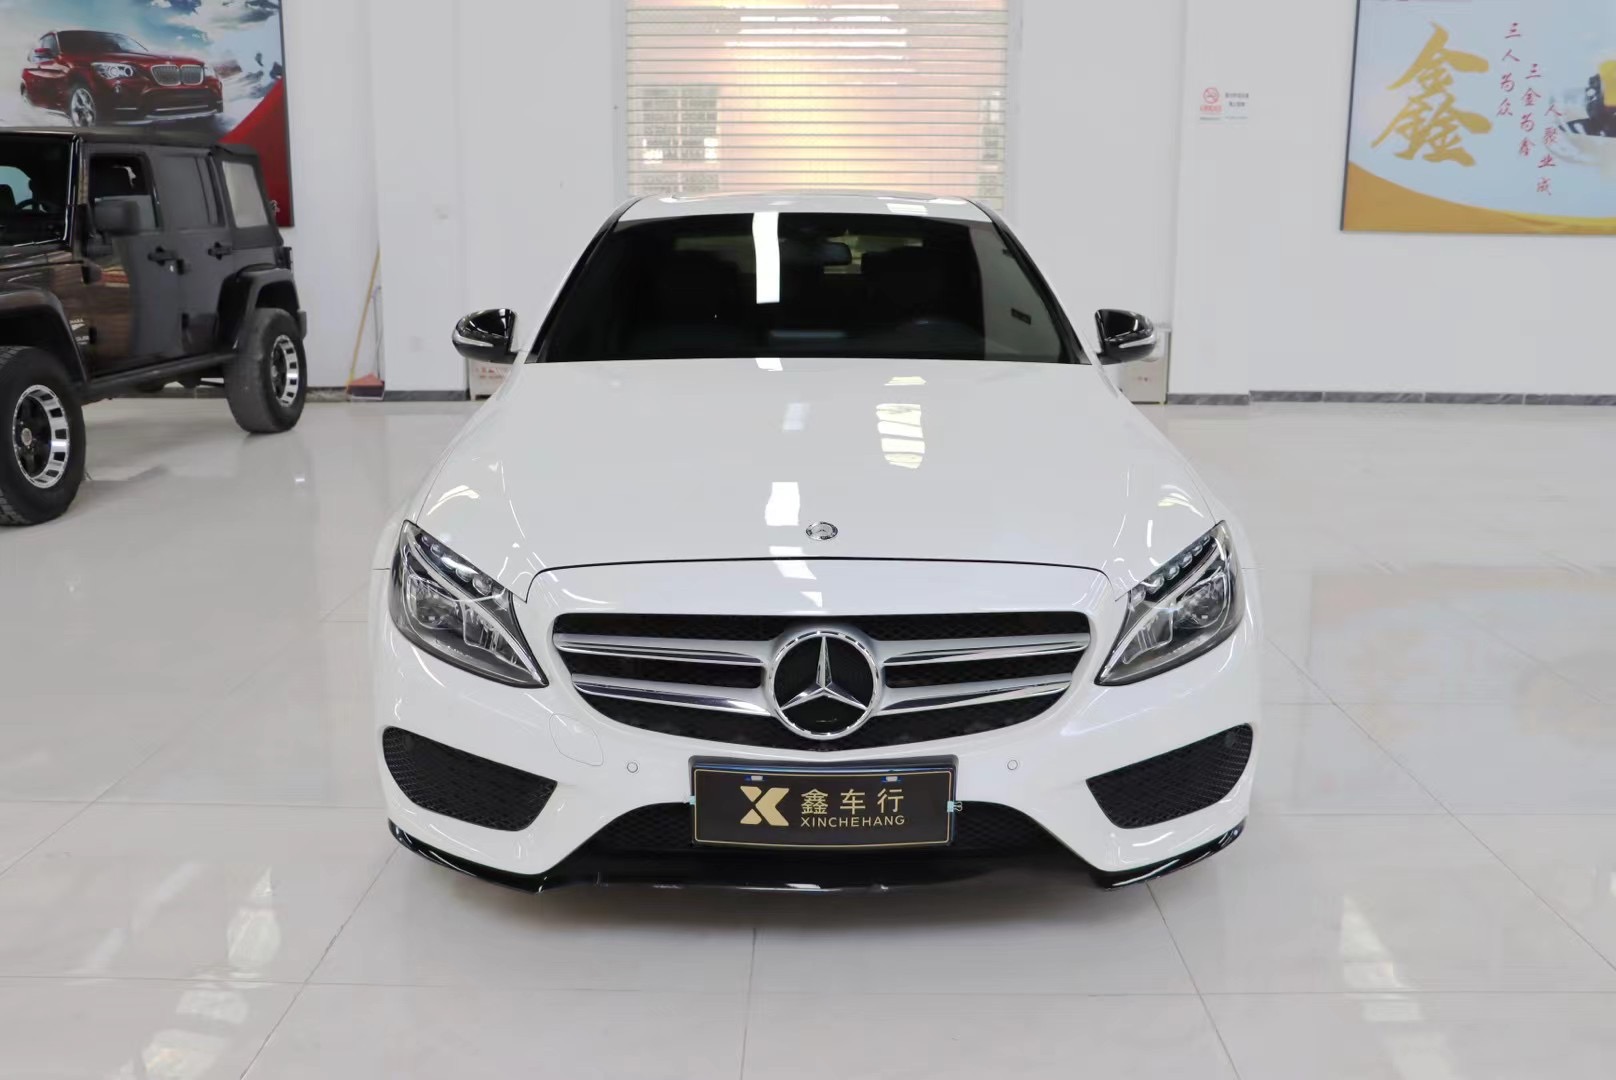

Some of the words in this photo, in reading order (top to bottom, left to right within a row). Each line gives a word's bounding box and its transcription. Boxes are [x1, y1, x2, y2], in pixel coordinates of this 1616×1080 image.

[1370, 20, 1493, 168] 鑫
[1496, 22, 1522, 116] 三人为众
[800, 788, 904, 815] 鑫车行
[800, 815, 906, 828] XINCHEHANG
